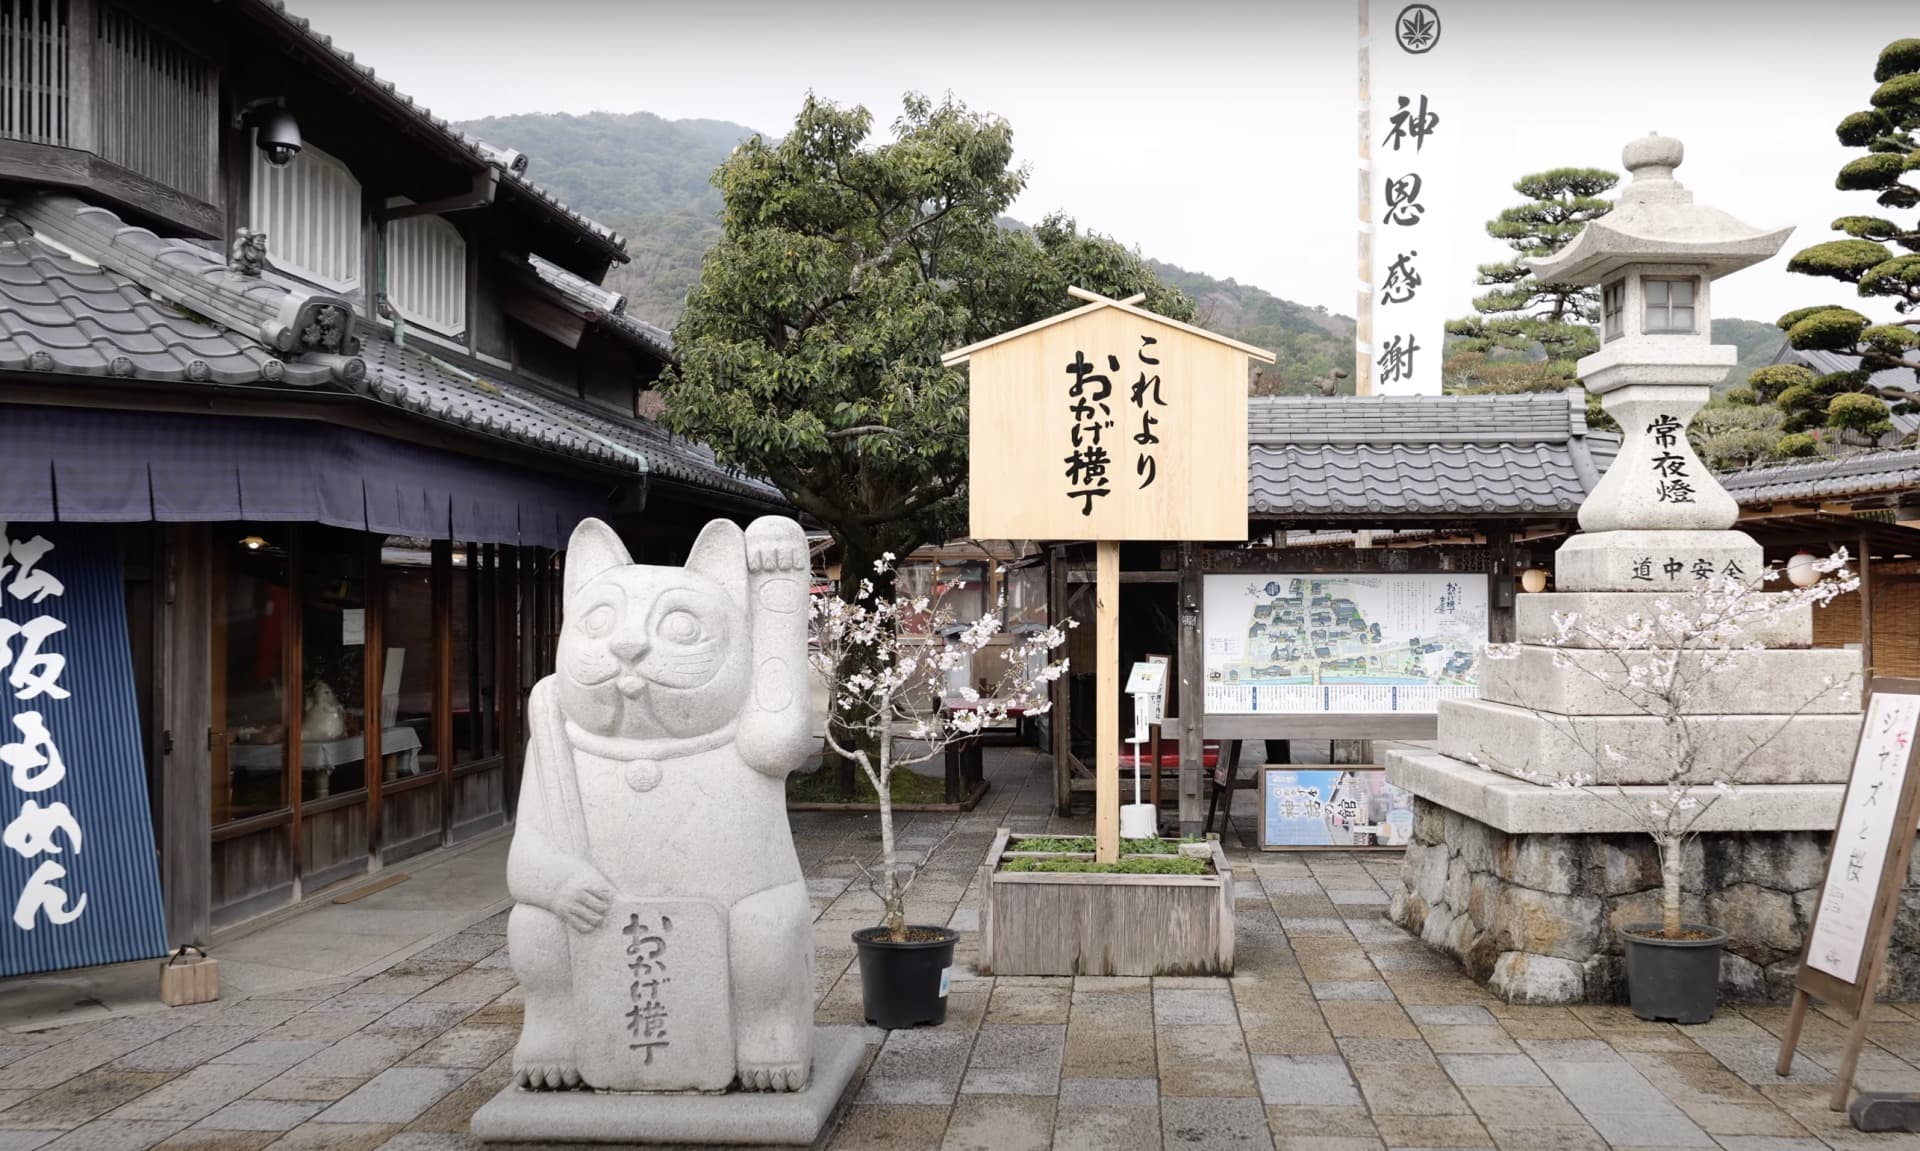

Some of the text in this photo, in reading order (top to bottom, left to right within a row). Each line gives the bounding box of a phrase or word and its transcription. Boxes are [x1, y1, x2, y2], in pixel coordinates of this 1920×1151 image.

[1377, 94, 1440, 385] 神恩感謝
[1064, 350, 1120, 516] おかげ横丁
[1131, 335, 1167, 490] これより
[1646, 415, 1696, 504] 常夜燈
[1631, 557, 1745, 581] 道中安全
[1281, 798, 1358, 819] 神話の館
[622, 913, 673, 1065] おかげ横丁
